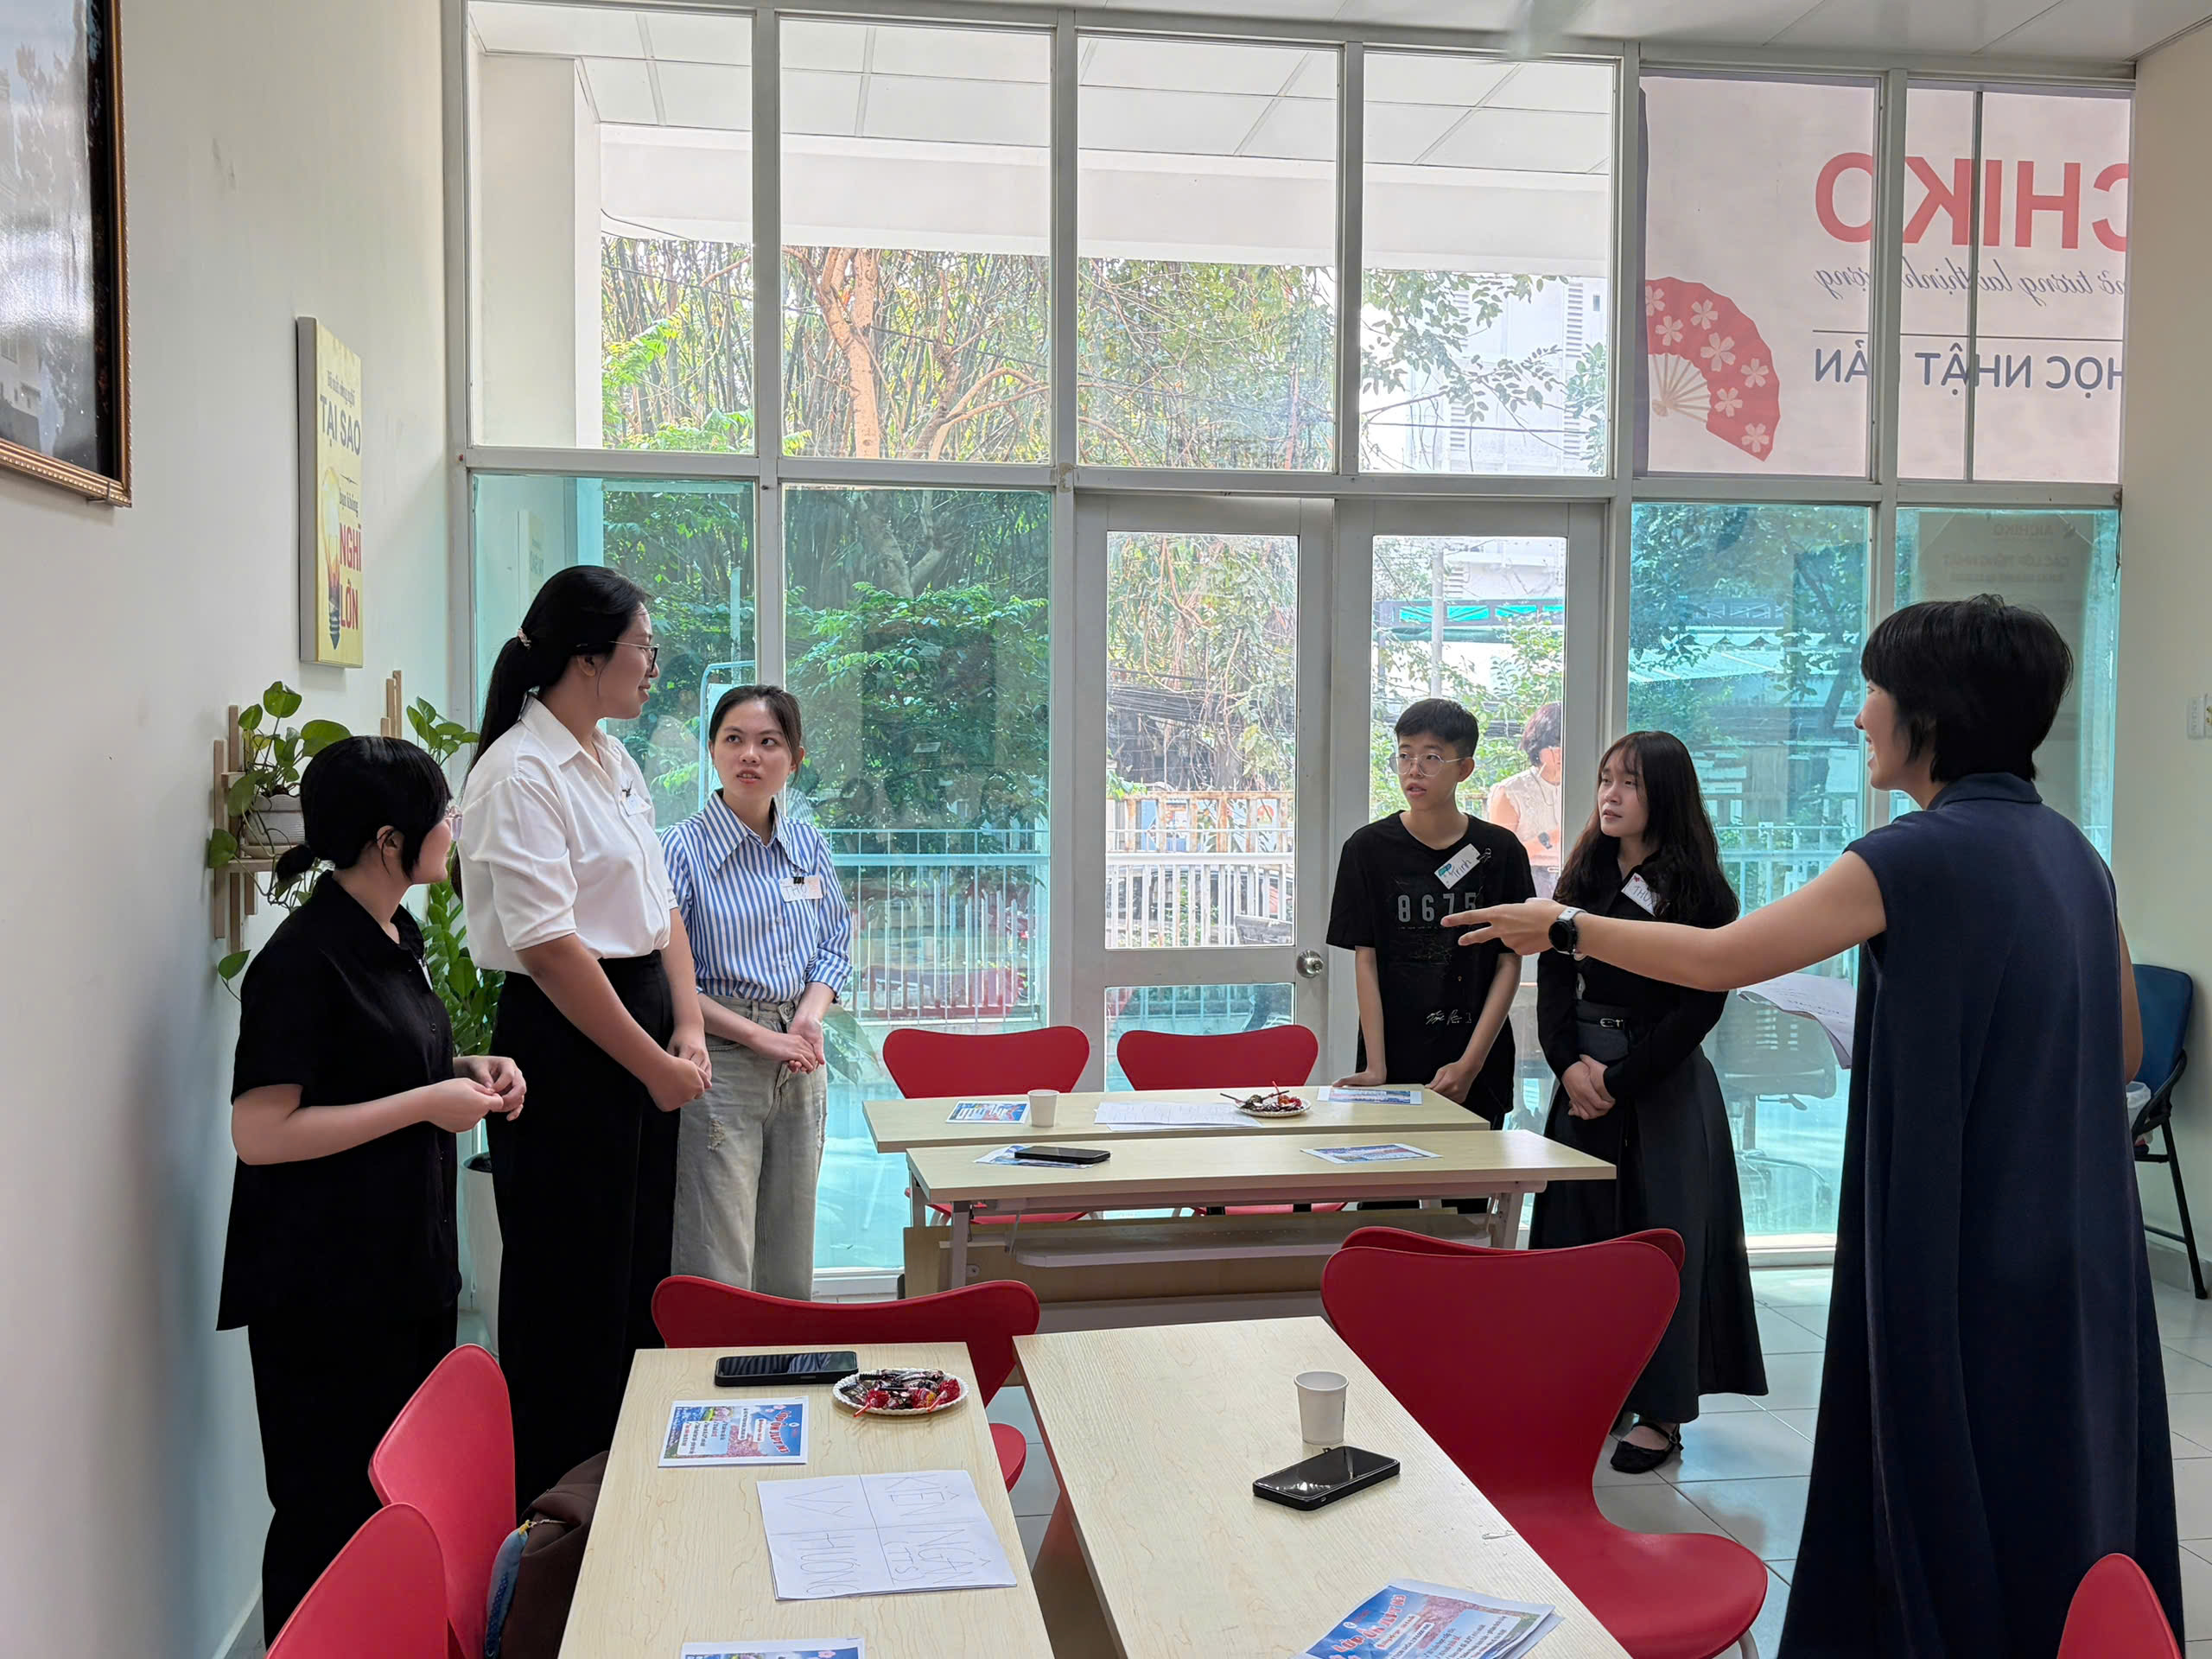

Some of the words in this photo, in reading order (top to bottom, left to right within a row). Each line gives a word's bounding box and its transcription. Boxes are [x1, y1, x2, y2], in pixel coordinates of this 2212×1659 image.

[320, 394, 338, 448] TẠI
[340, 409, 360, 455] SAO
[1398, 893, 1477, 923] 8675
[906, 1529, 992, 1585] NGÂN
[1378, 1606, 1402, 1629] JLPT
